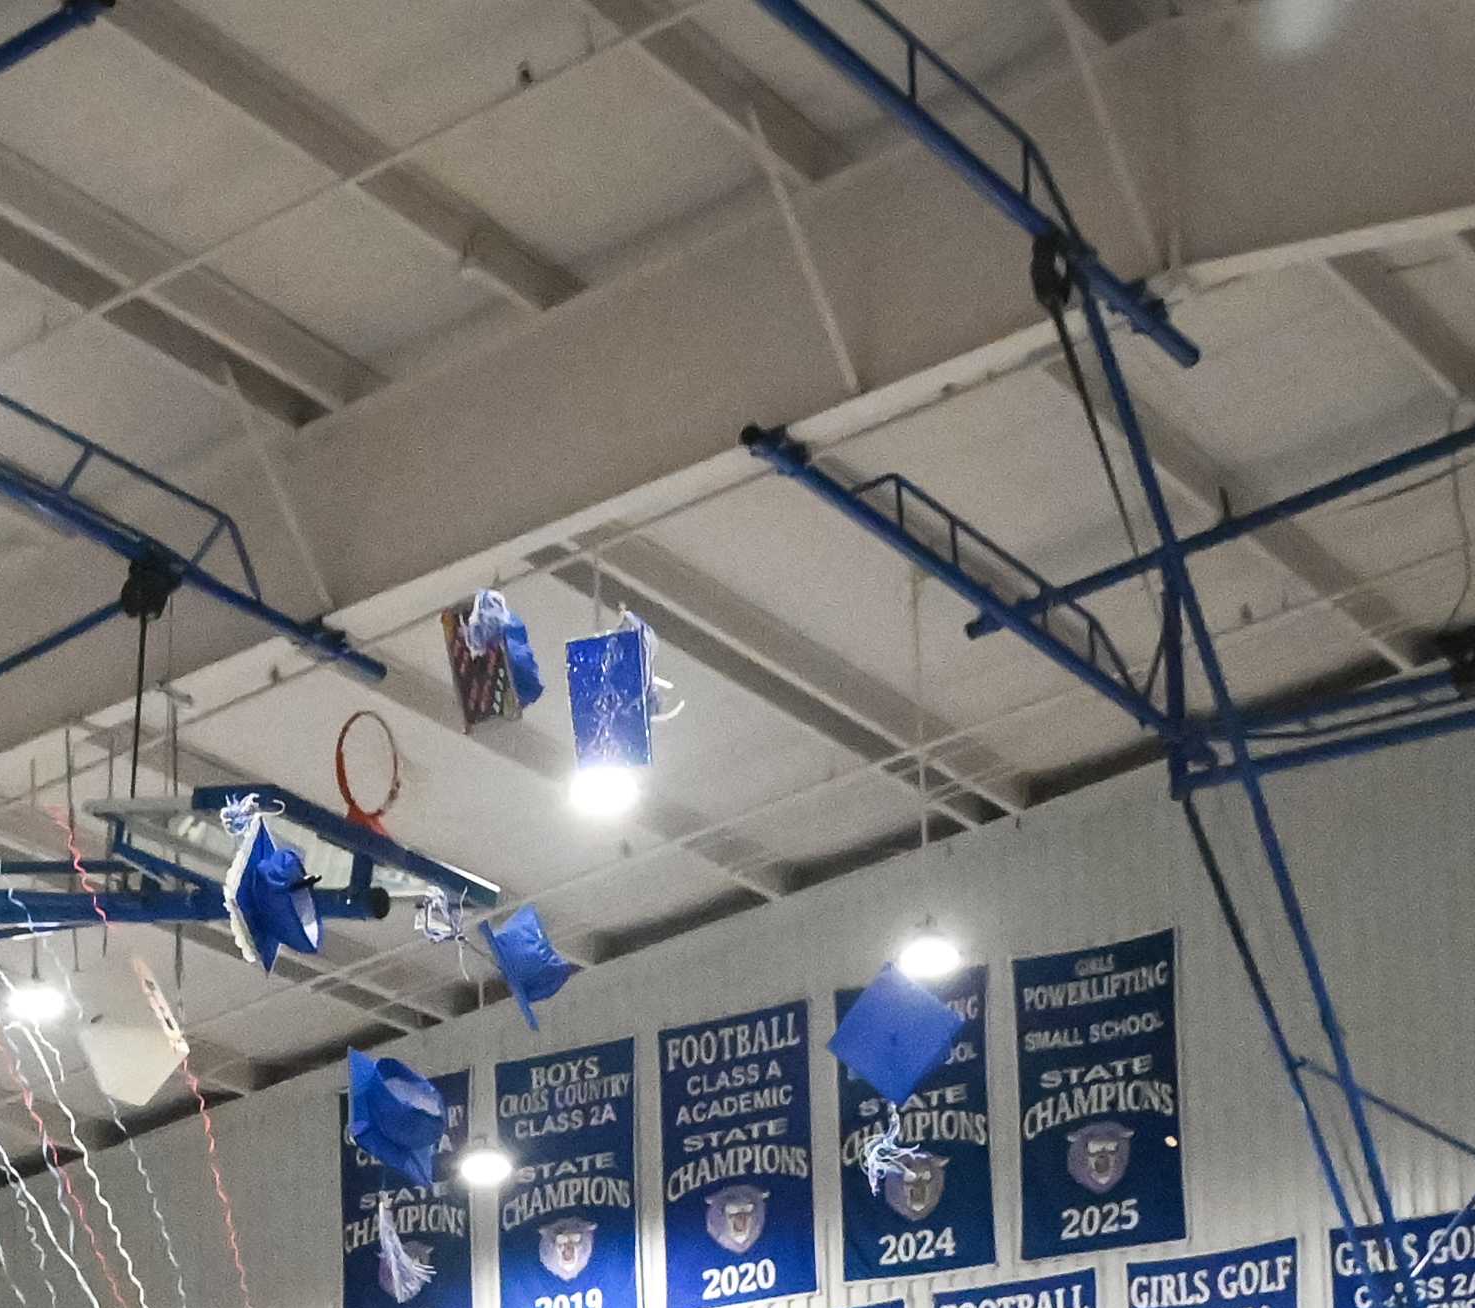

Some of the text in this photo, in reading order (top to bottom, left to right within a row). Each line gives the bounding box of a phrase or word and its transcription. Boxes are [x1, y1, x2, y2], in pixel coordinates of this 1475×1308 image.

[1023, 960, 1168, 1010] POWERLIFTING
[666, 1012, 800, 1072] FOOTBALL
[1024, 1010, 1164, 1052] SMALL SCHOOL
[530, 1057, 600, 1088] BOYS
[687, 1060, 782, 1096] CLASS A
[1041, 1054, 1152, 1088] STATE
[500, 1088, 549, 1118] CROSS
[556, 1072, 631, 1109] COUNTRY
[676, 1085, 793, 1126] ACADEMIC
[1024, 1080, 1174, 1140] CHAMPIONS
[514, 1103, 617, 1139] CLASS 2A
[683, 1118, 788, 1152] STATE
[666, 1145, 808, 1202] CHAMPIONS
[502, 1177, 631, 1231] CHAMPIONS
[1061, 1199, 1139, 1240] 2025
[879, 1227, 955, 1266] 2024
[702, 1258, 776, 1300] 2020
[1217, 1256, 1293, 1300] GOLF
